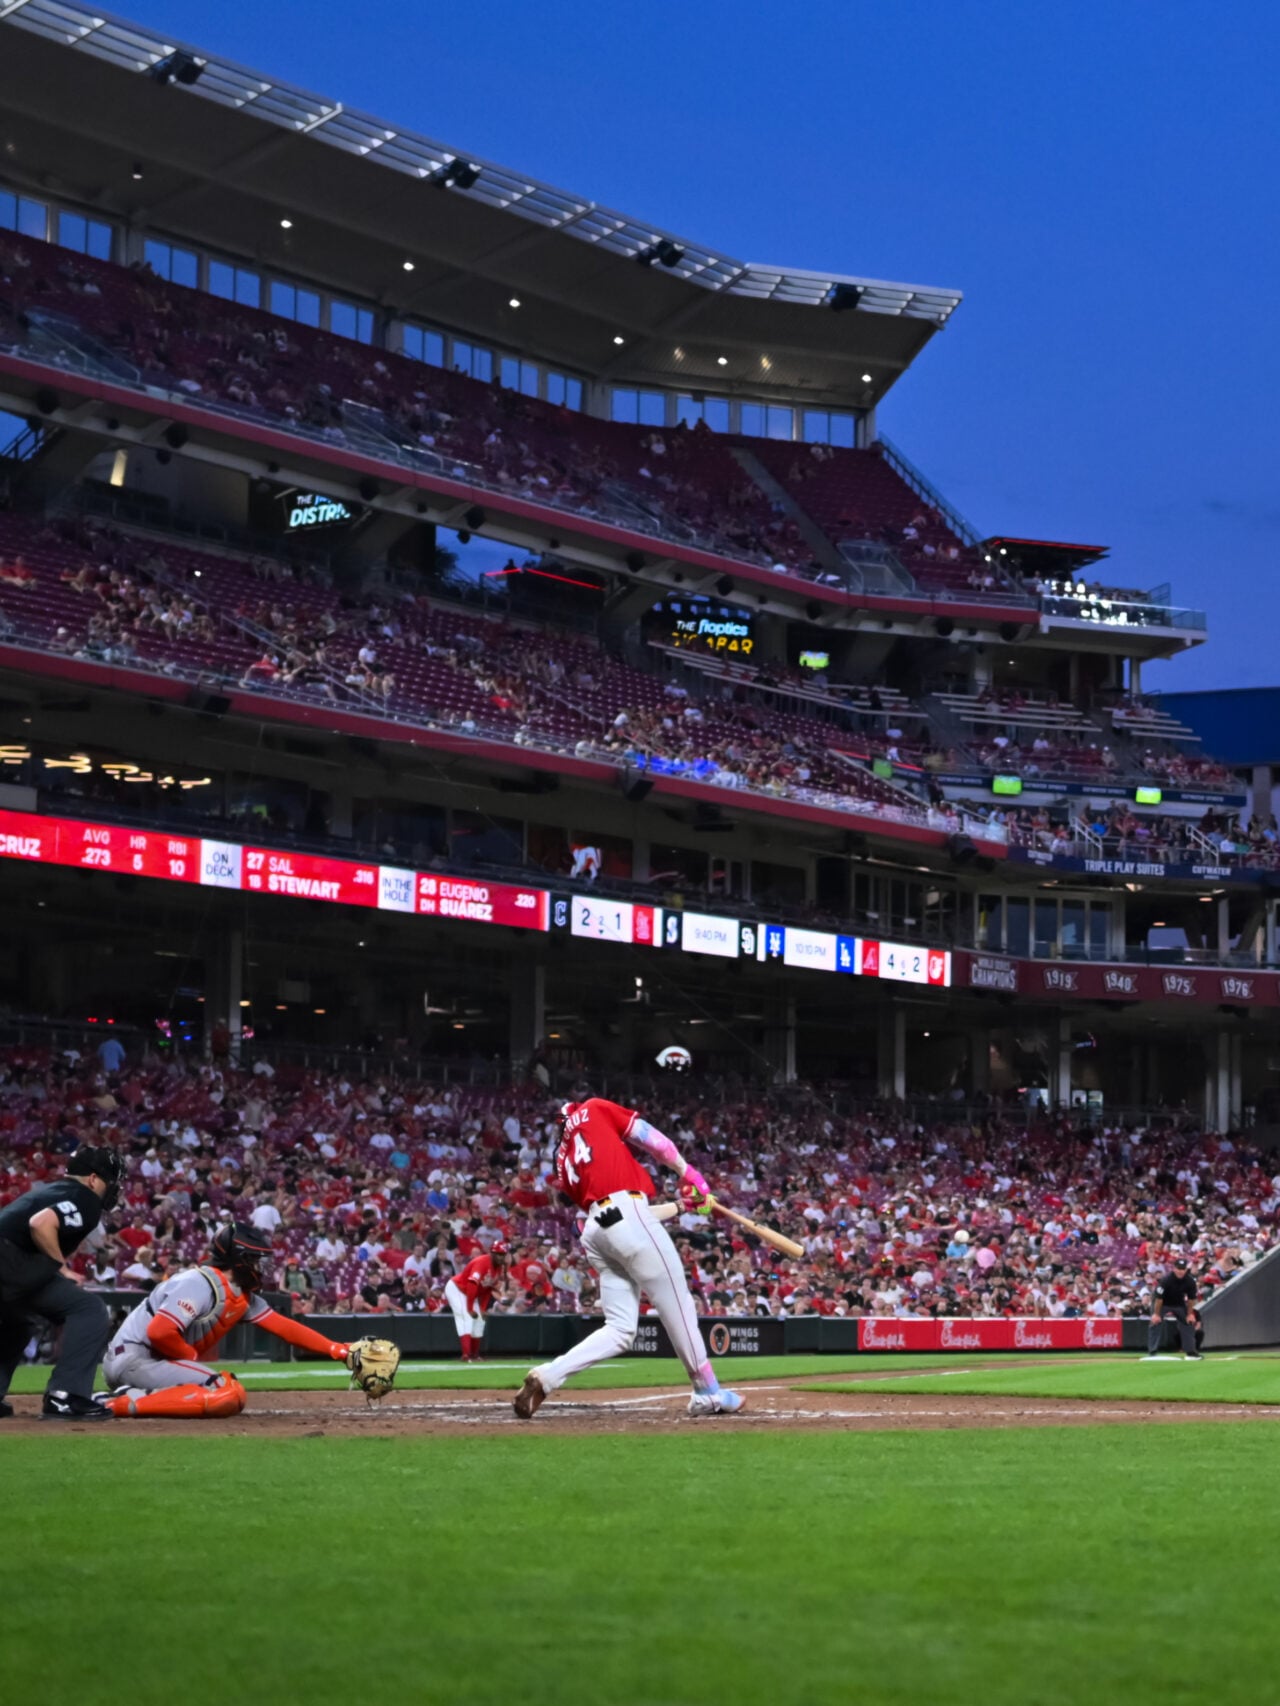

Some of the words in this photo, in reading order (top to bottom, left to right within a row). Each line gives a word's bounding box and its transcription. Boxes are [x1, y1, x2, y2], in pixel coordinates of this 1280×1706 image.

[297, 494, 313, 505] THE
[677, 620, 696, 631] THE
[83, 829, 110, 844] AVG
[130, 836, 146, 849] HR
[168, 841, 187, 856] RBI
[82, 848, 111, 866] .273
[170, 860, 185, 876] 10
[213, 852, 228, 864] ON
[206, 865, 234, 877] DECK
[247, 852, 264, 869] 27
[269, 857, 294, 874] SAL
[353, 870, 374, 885] .316
[1085, 859, 1112, 873] TRIPLE
[1114, 861, 1135, 874] PLAY
[1136, 862, 1164, 876] SUITES
[268, 874, 341, 899] STEWART
[383, 878, 391, 888] IN
[395, 879, 412, 891] THE
[420, 878, 436, 894] 28
[439, 882, 488, 902] EUGENIO
[514, 894, 536, 908] .220
[384, 891, 409, 903] HOLE
[420, 899, 435, 912] DH
[439, 898, 493, 920] SUÁREZ
[695, 928, 713, 940] 9:40
[714, 930, 727, 942] PM
[814, 945, 826, 956] PM
[1046, 970, 1072, 988] 1919
[1105, 970, 1131, 992] 1940
[1164, 975, 1190, 994] 1975
[1223, 978, 1249, 997] 1976
[730, 1328, 759, 1338] WINGS
[731, 1342, 759, 1352] RINGS
